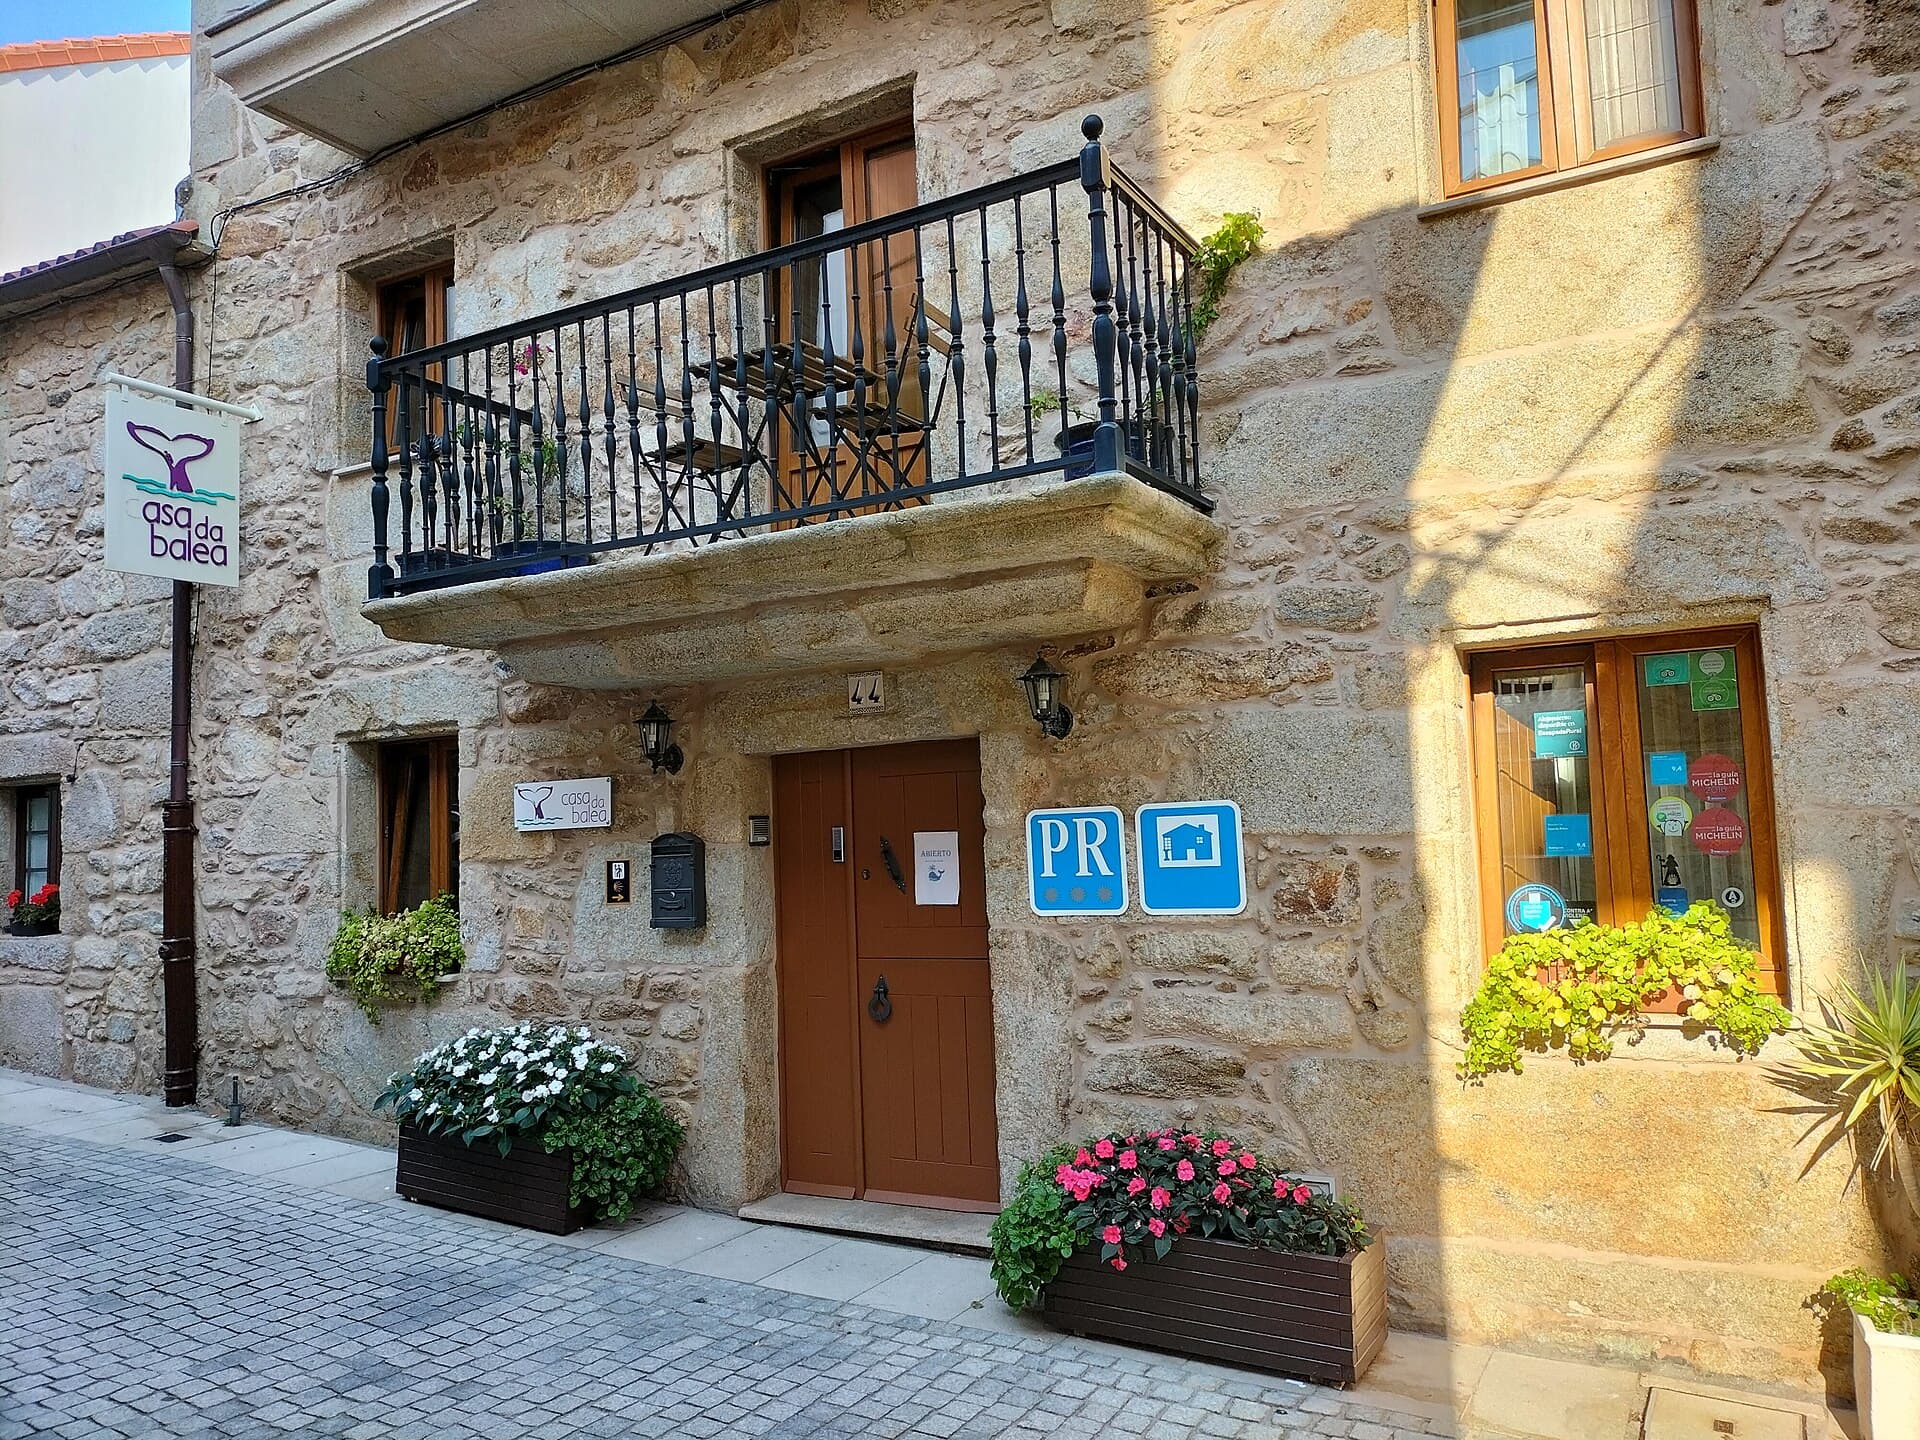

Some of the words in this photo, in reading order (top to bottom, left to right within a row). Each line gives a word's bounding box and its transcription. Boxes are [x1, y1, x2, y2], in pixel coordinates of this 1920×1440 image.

[195, 515, 223, 542] da
[150, 523, 228, 566] balea
[851, 678, 880, 704] 44
[1692, 777, 1739, 787] MICHELIN
[561, 791, 590, 806] casa
[591, 794, 605, 808] da
[572, 804, 607, 824] balea
[1695, 831, 1743, 840] MICHELIN
[920, 849, 952, 857] ABIERTO
[1037, 817, 1114, 877] PR
